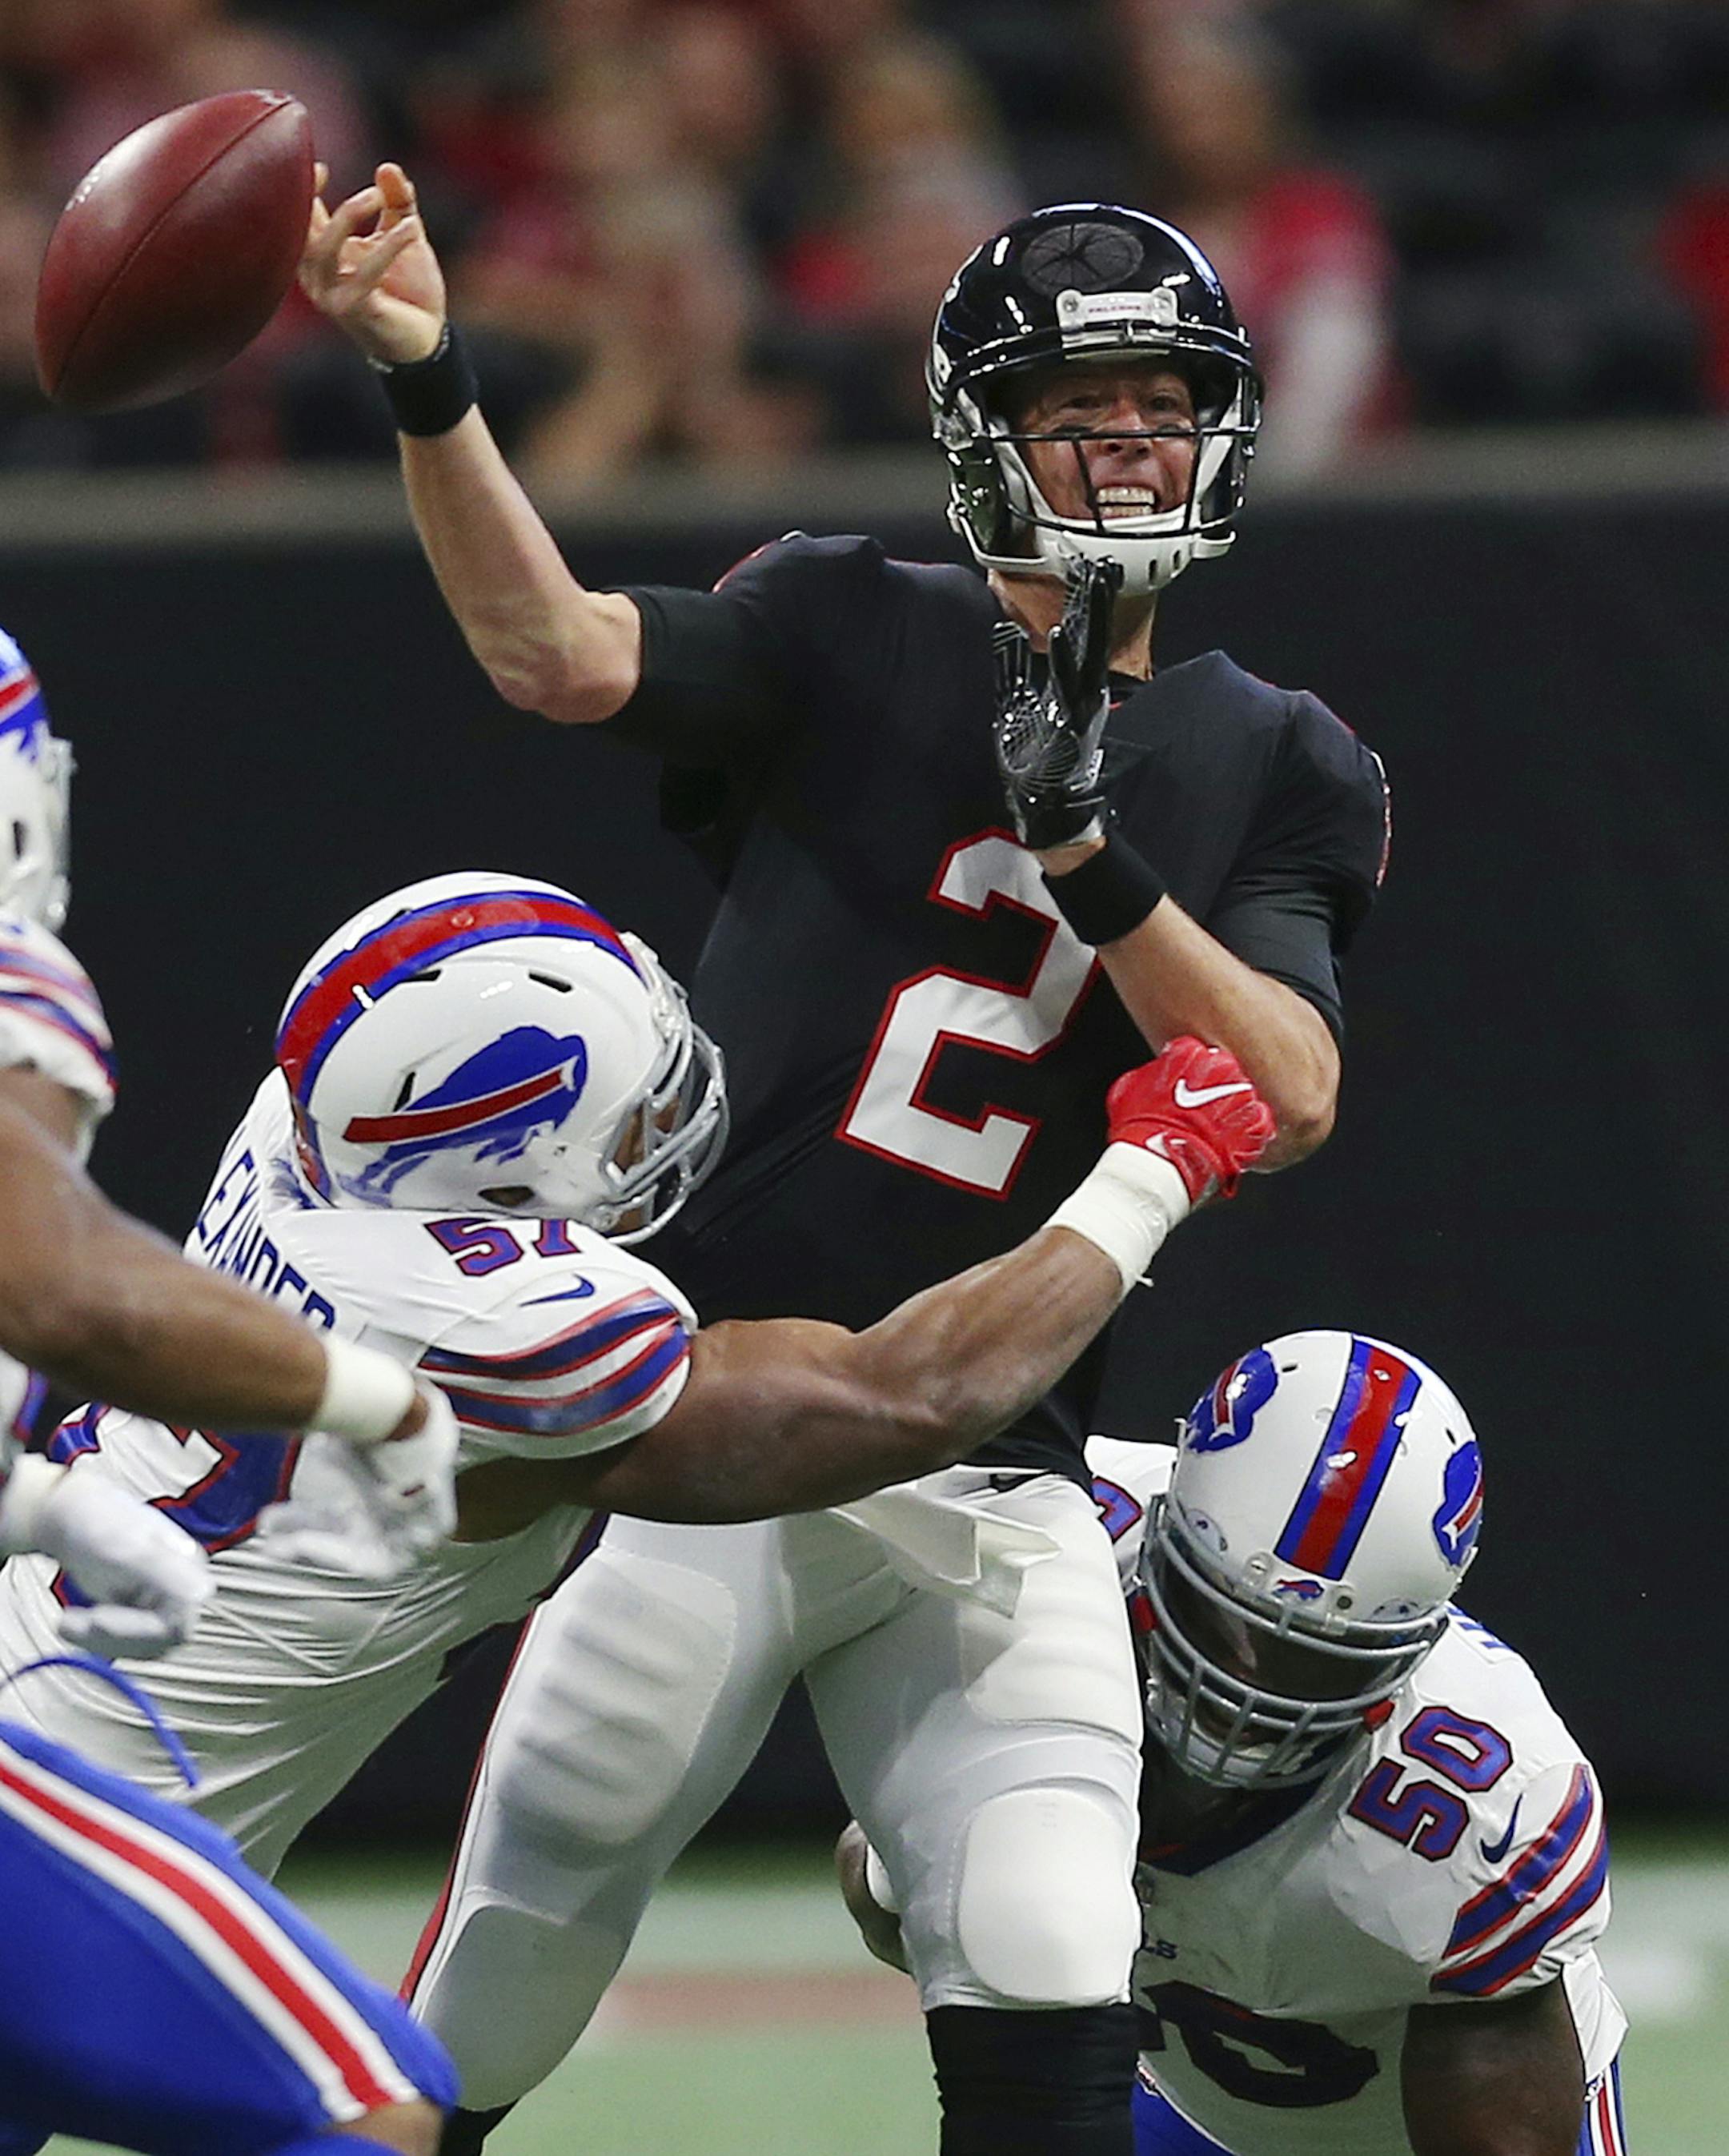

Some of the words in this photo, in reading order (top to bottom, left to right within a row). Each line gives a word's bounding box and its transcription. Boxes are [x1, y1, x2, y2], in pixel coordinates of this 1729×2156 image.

[835, 825, 1102, 1201] 2
[1347, 1706, 1513, 1861] 50
[1140, 1977, 1382, 2109] 0
